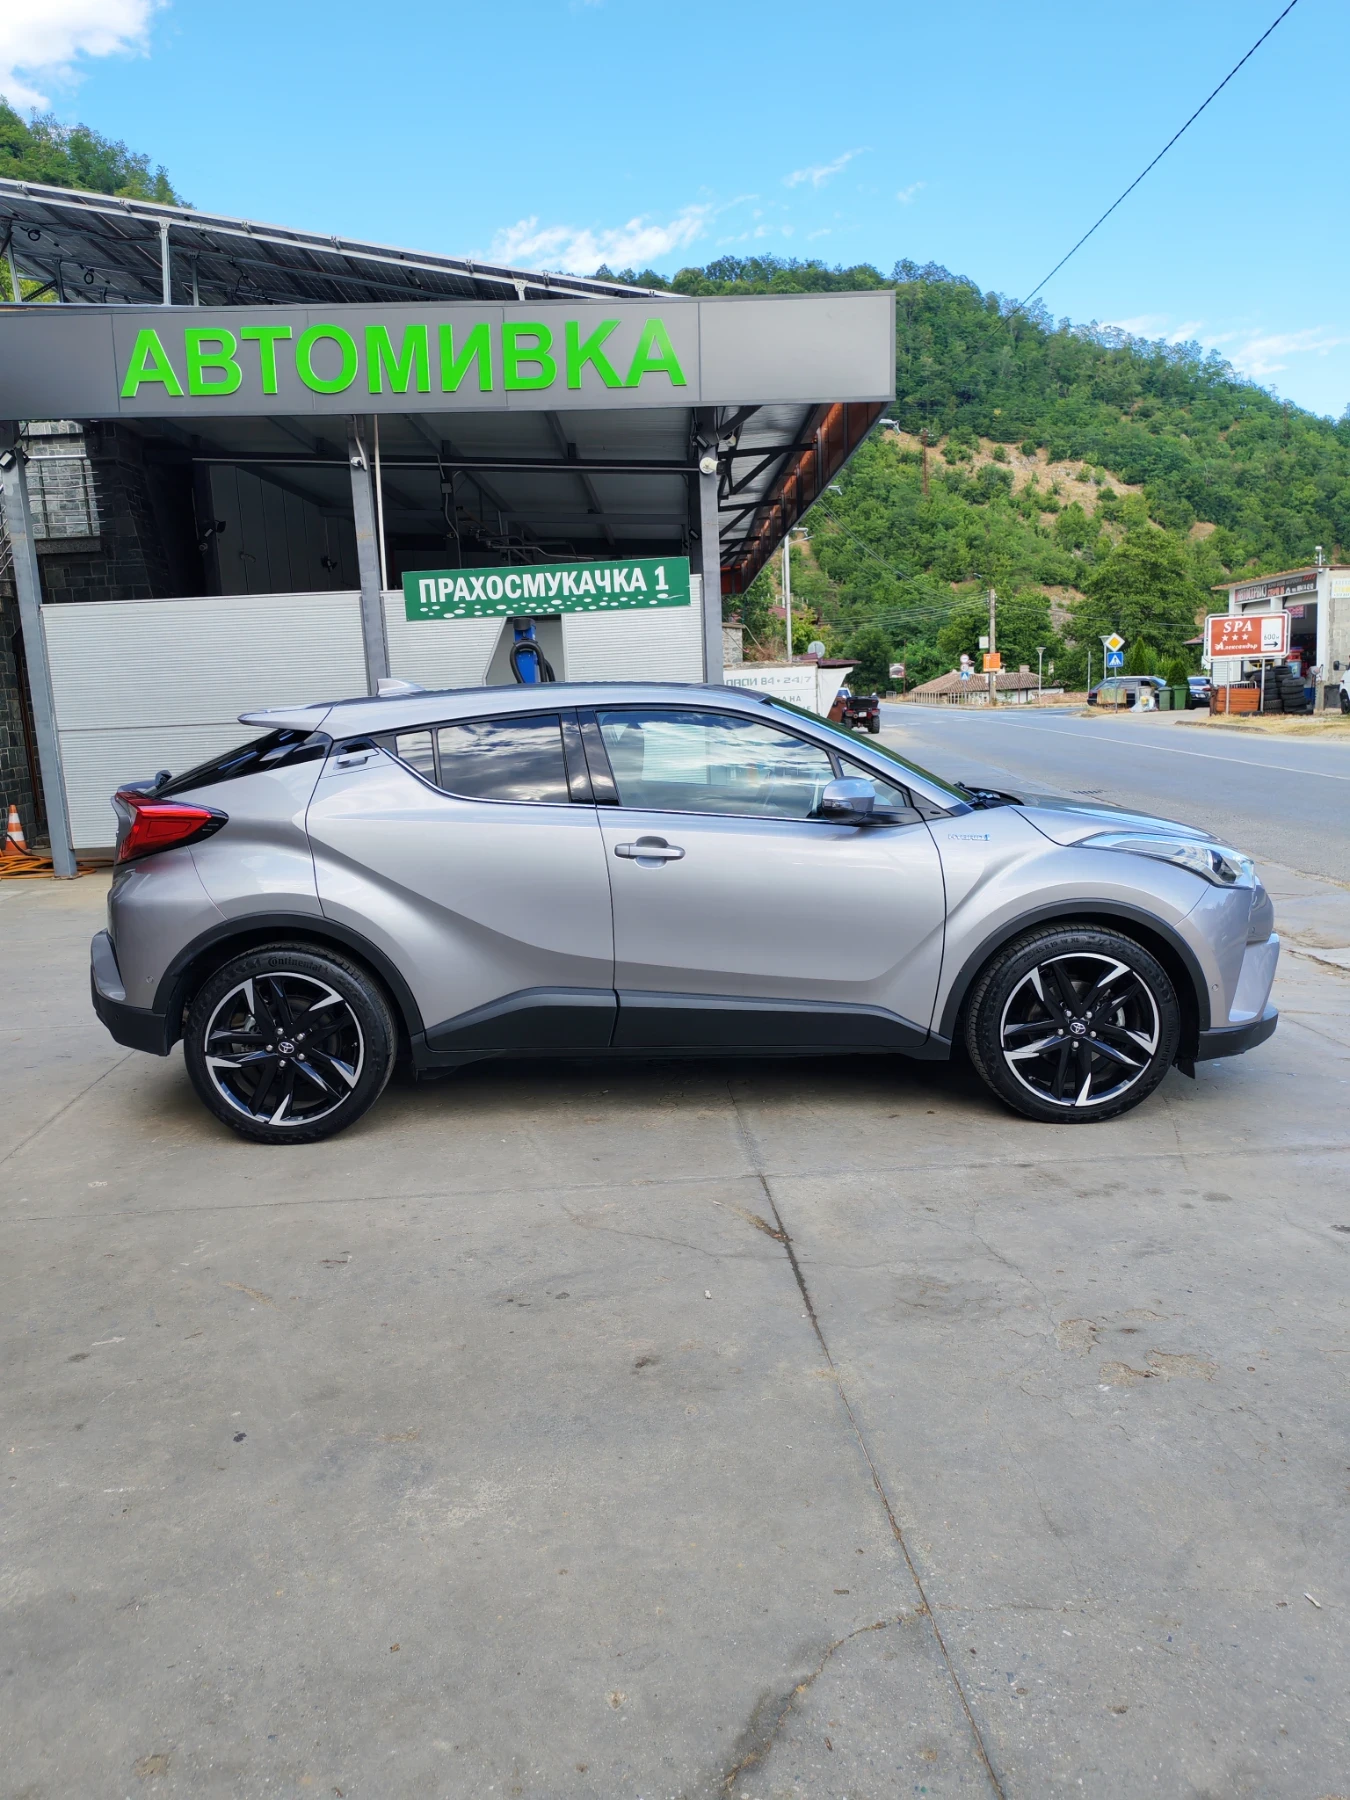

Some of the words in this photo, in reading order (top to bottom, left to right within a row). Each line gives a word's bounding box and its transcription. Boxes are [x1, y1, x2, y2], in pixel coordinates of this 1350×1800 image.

[119, 318, 688, 399] АВТОМИВКА
[418, 567, 648, 603] ПРАХОСМУКАЧКА
[654, 565, 669, 591] 1
[1223, 619, 1253, 634] SPA
[760, 676, 775, 686] 84
[268, 957, 322, 973] Continental
